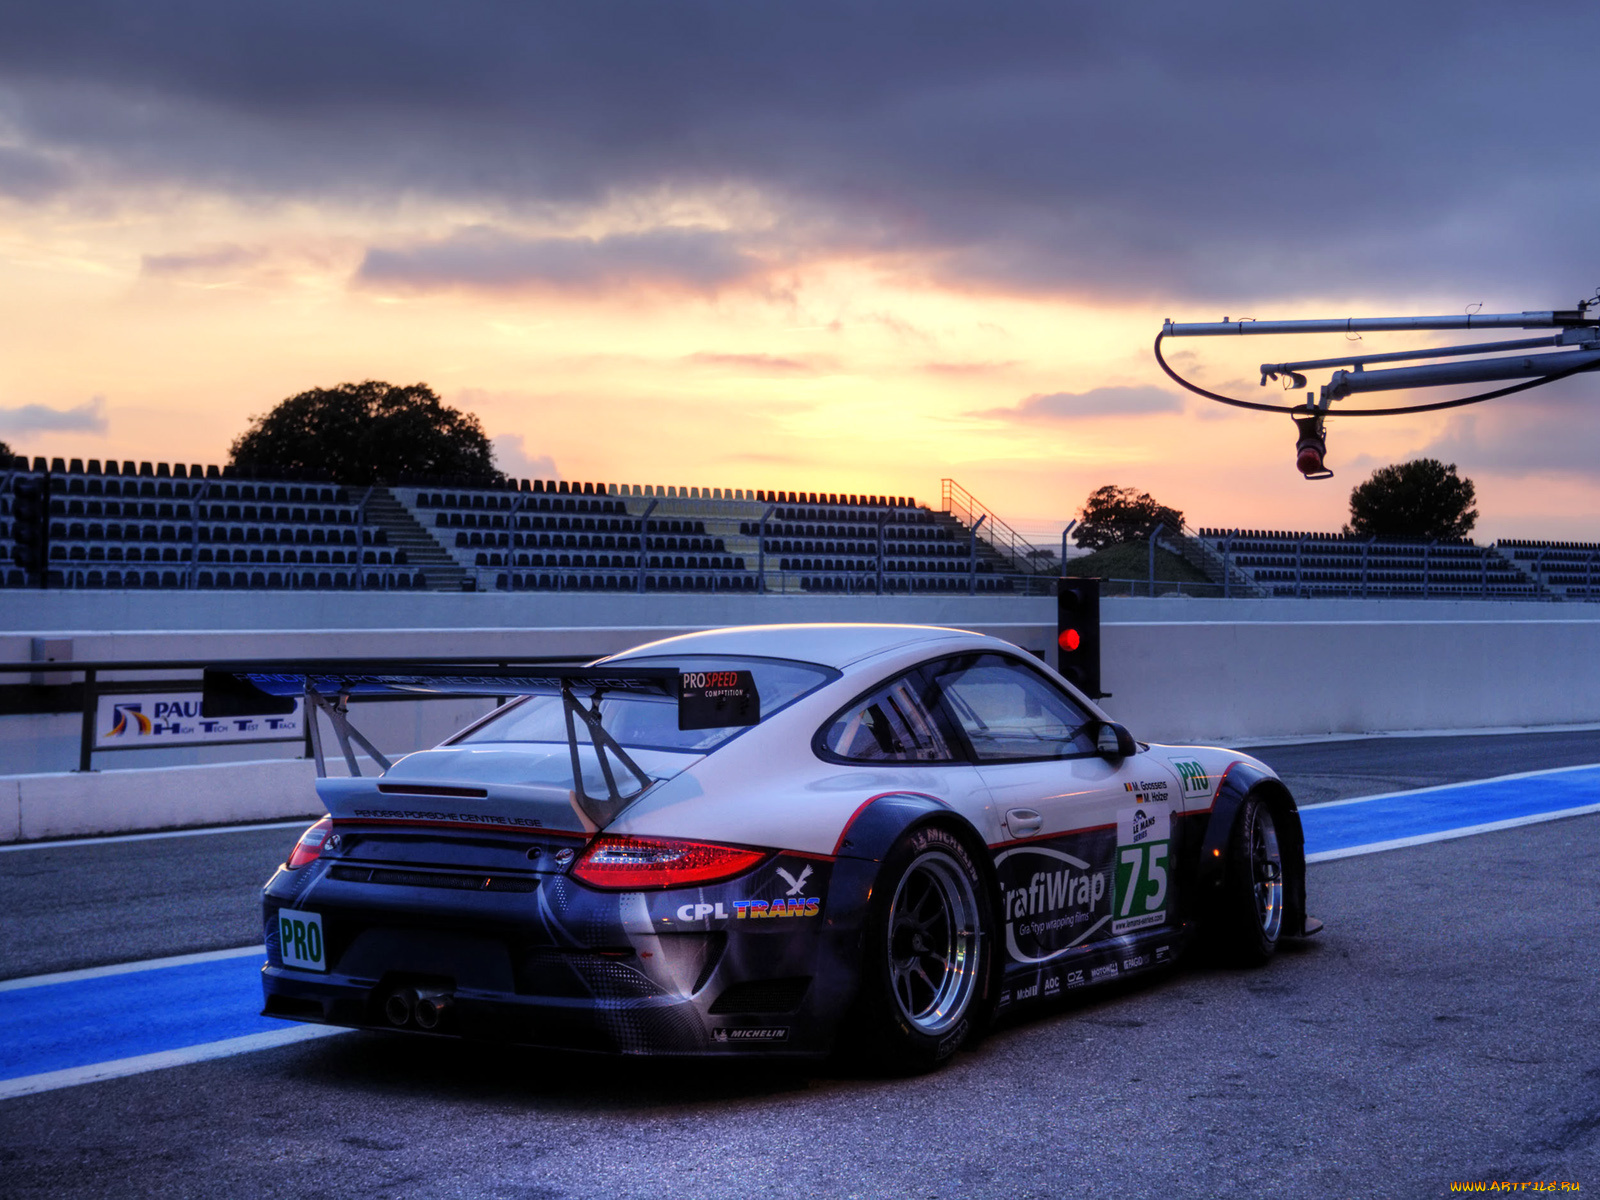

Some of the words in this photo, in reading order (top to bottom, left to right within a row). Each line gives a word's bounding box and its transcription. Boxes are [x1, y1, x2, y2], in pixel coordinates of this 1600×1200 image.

[683, 672, 738, 688] PROSPEED
[1140, 781, 1168, 791] Goossens
[1175, 761, 1208, 792] PRO
[354, 810, 404, 819] PENDERS
[404, 811, 459, 821] PORSCHE
[460, 813, 507, 824] CENTRE
[509, 817, 543, 827] LIEGE
[1133, 825, 1139, 835] LE
[1140, 816, 1155, 831] MANS
[1133, 830, 1148, 843] SERIES
[926, 828, 979, 881] MICHELIN
[1121, 844, 1168, 917] 75
[1000, 870, 1105, 920] rafiWrap
[676, 902, 729, 921] CPL
[732, 897, 820, 919] TRANS
[281, 918, 321, 962] PRO
[1044, 976, 1060, 990] AOC
[730, 1029, 786, 1039] MICHELIN
